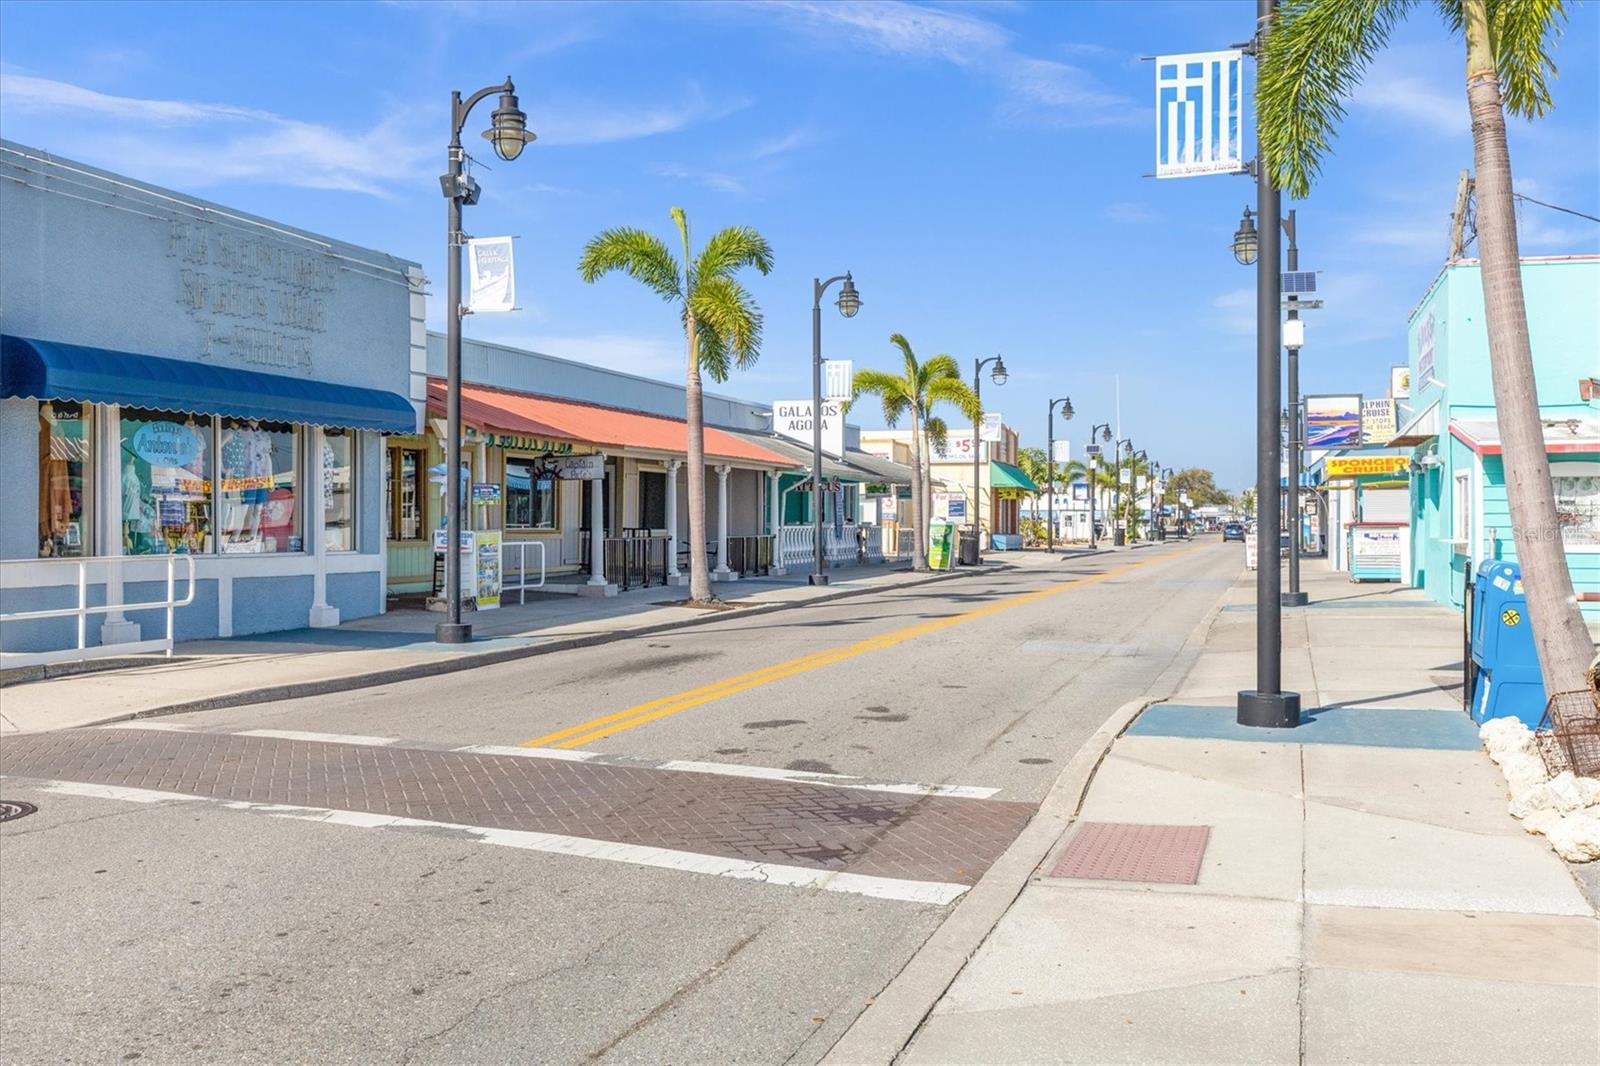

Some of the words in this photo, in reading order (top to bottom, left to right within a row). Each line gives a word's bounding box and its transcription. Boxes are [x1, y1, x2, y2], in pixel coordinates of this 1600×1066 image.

[779, 406, 838, 417] GALAOS
[788, 420, 829, 431] AGOA
[1331, 457, 1409, 467] SPONGEO
[1343, 466, 1394, 474] CRUISE
